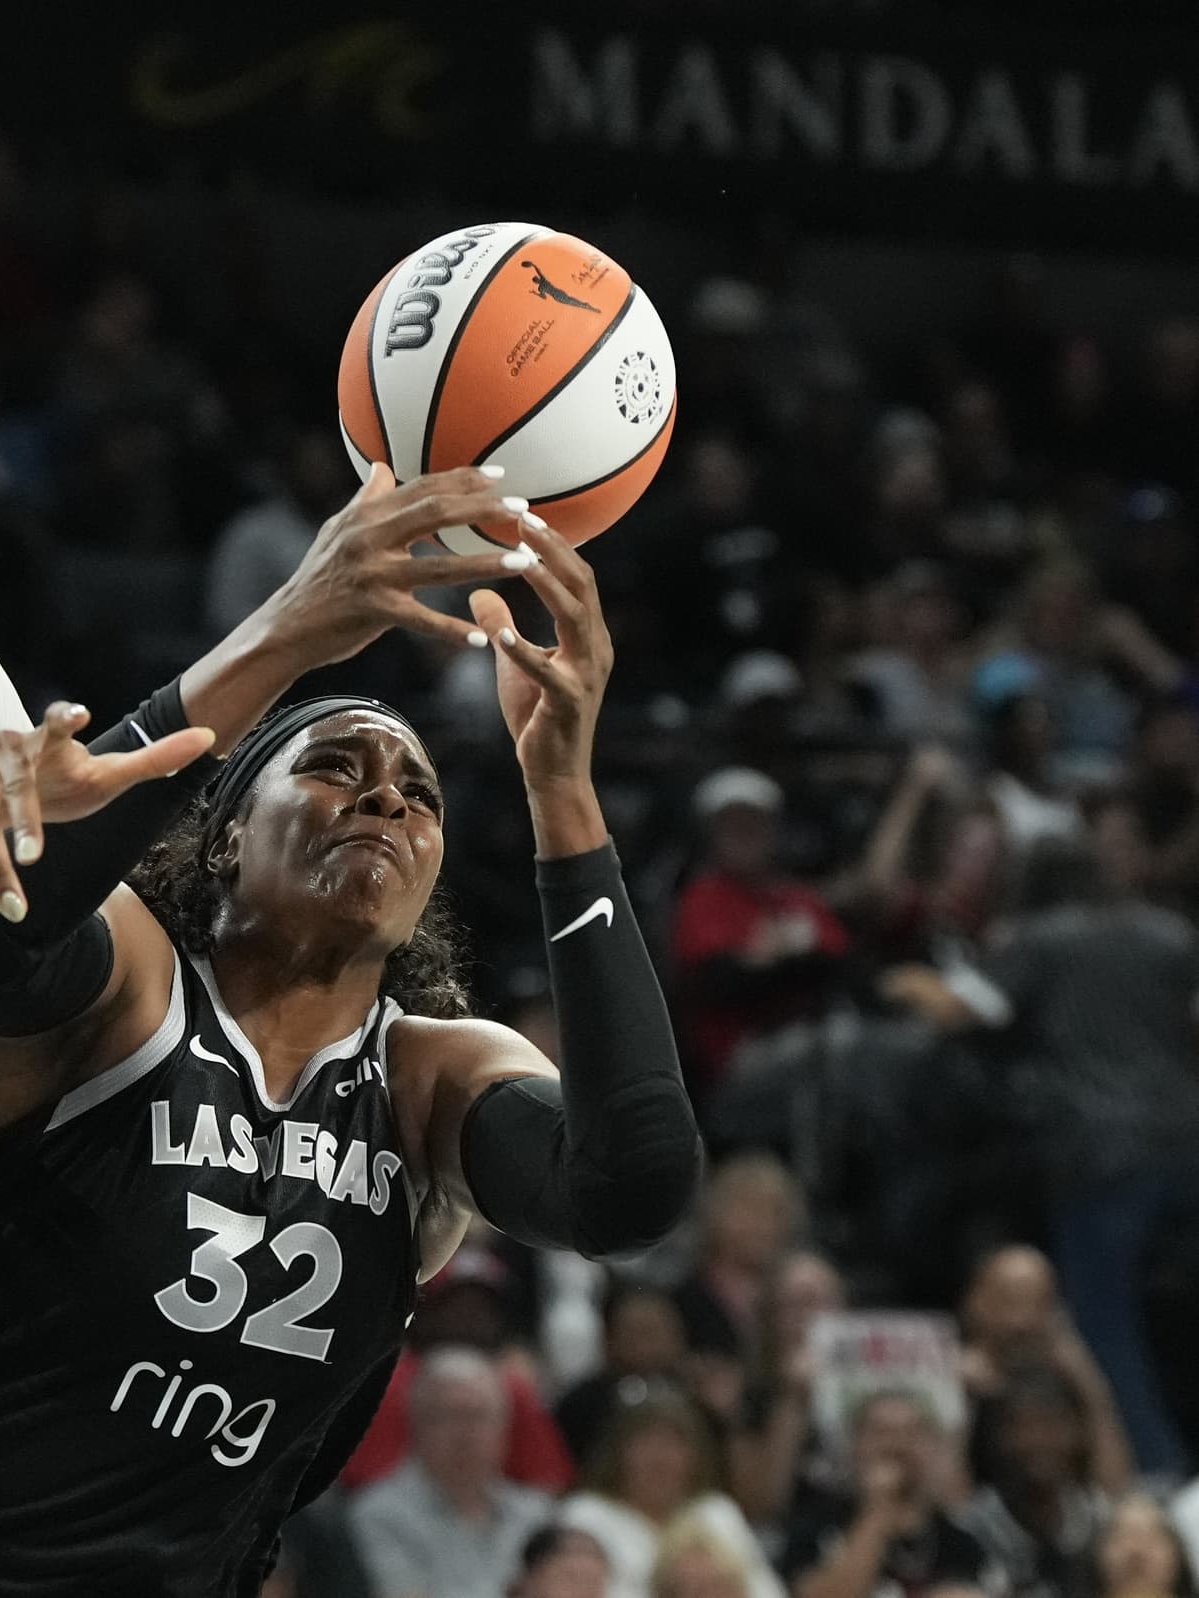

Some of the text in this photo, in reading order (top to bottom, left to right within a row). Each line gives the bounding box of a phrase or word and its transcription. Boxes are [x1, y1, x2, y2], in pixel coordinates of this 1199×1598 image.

[529, 26, 1199, 188] MANDALA
[384, 225, 498, 359] Wilso
[506, 320, 542, 364] OFFICIAL
[510, 319, 555, 377] GAME BALL
[151, 1100, 402, 1216] LAS VEGAS
[153, 1191, 344, 1362] 32
[109, 1359, 277, 1468] ring
